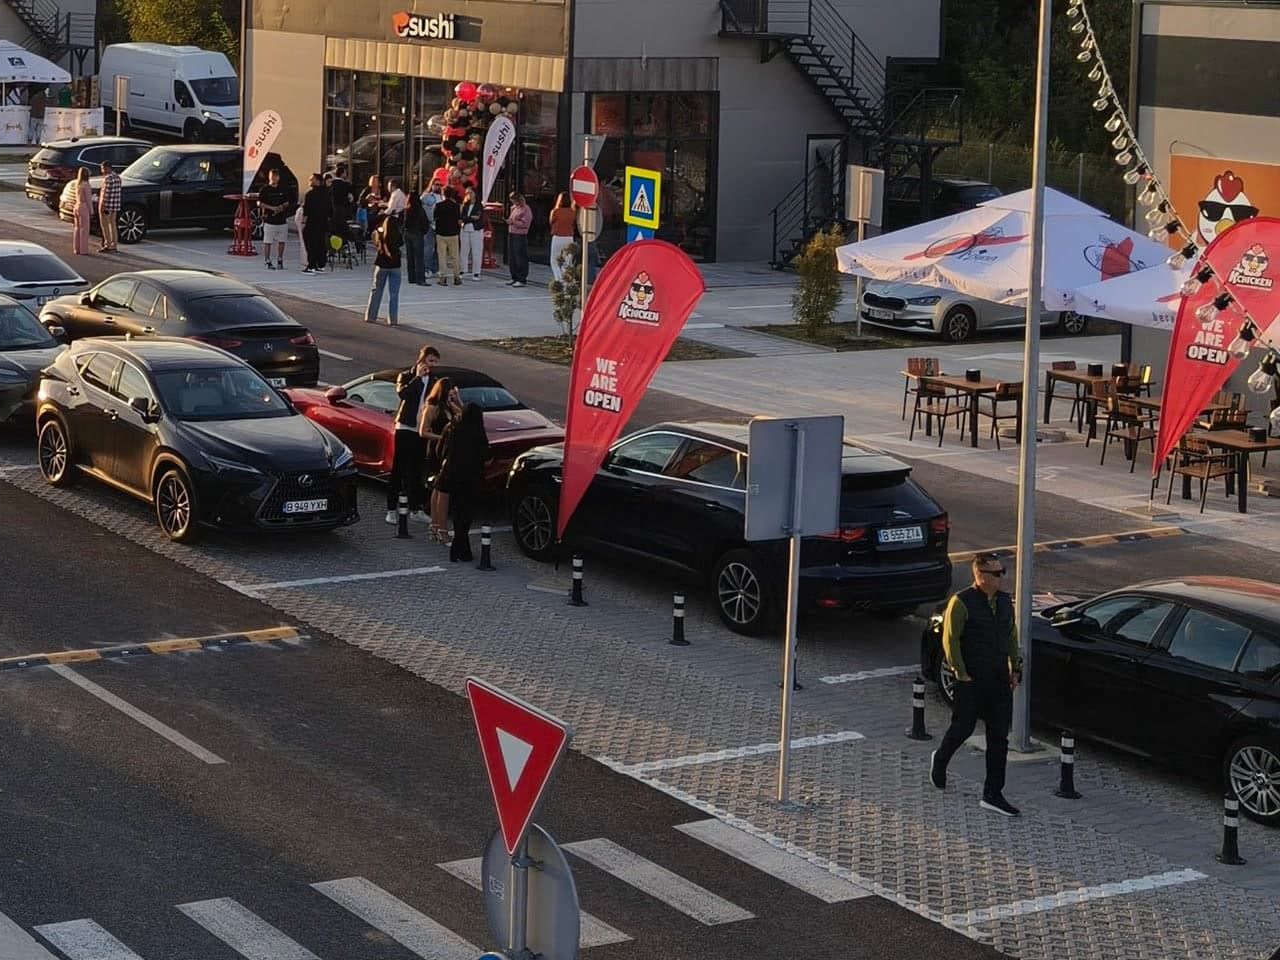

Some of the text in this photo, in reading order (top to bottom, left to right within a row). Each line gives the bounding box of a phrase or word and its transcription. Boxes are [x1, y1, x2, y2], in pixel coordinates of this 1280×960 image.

[1195, 330, 1224, 347] ARE
[1188, 346, 1228, 364] OPEN
[596, 357, 617, 375] WE
[590, 374, 618, 392] ARE
[584, 391, 621, 412] OPEN
[294, 502, 309, 512] 949
[311, 500, 327, 510] YXH
